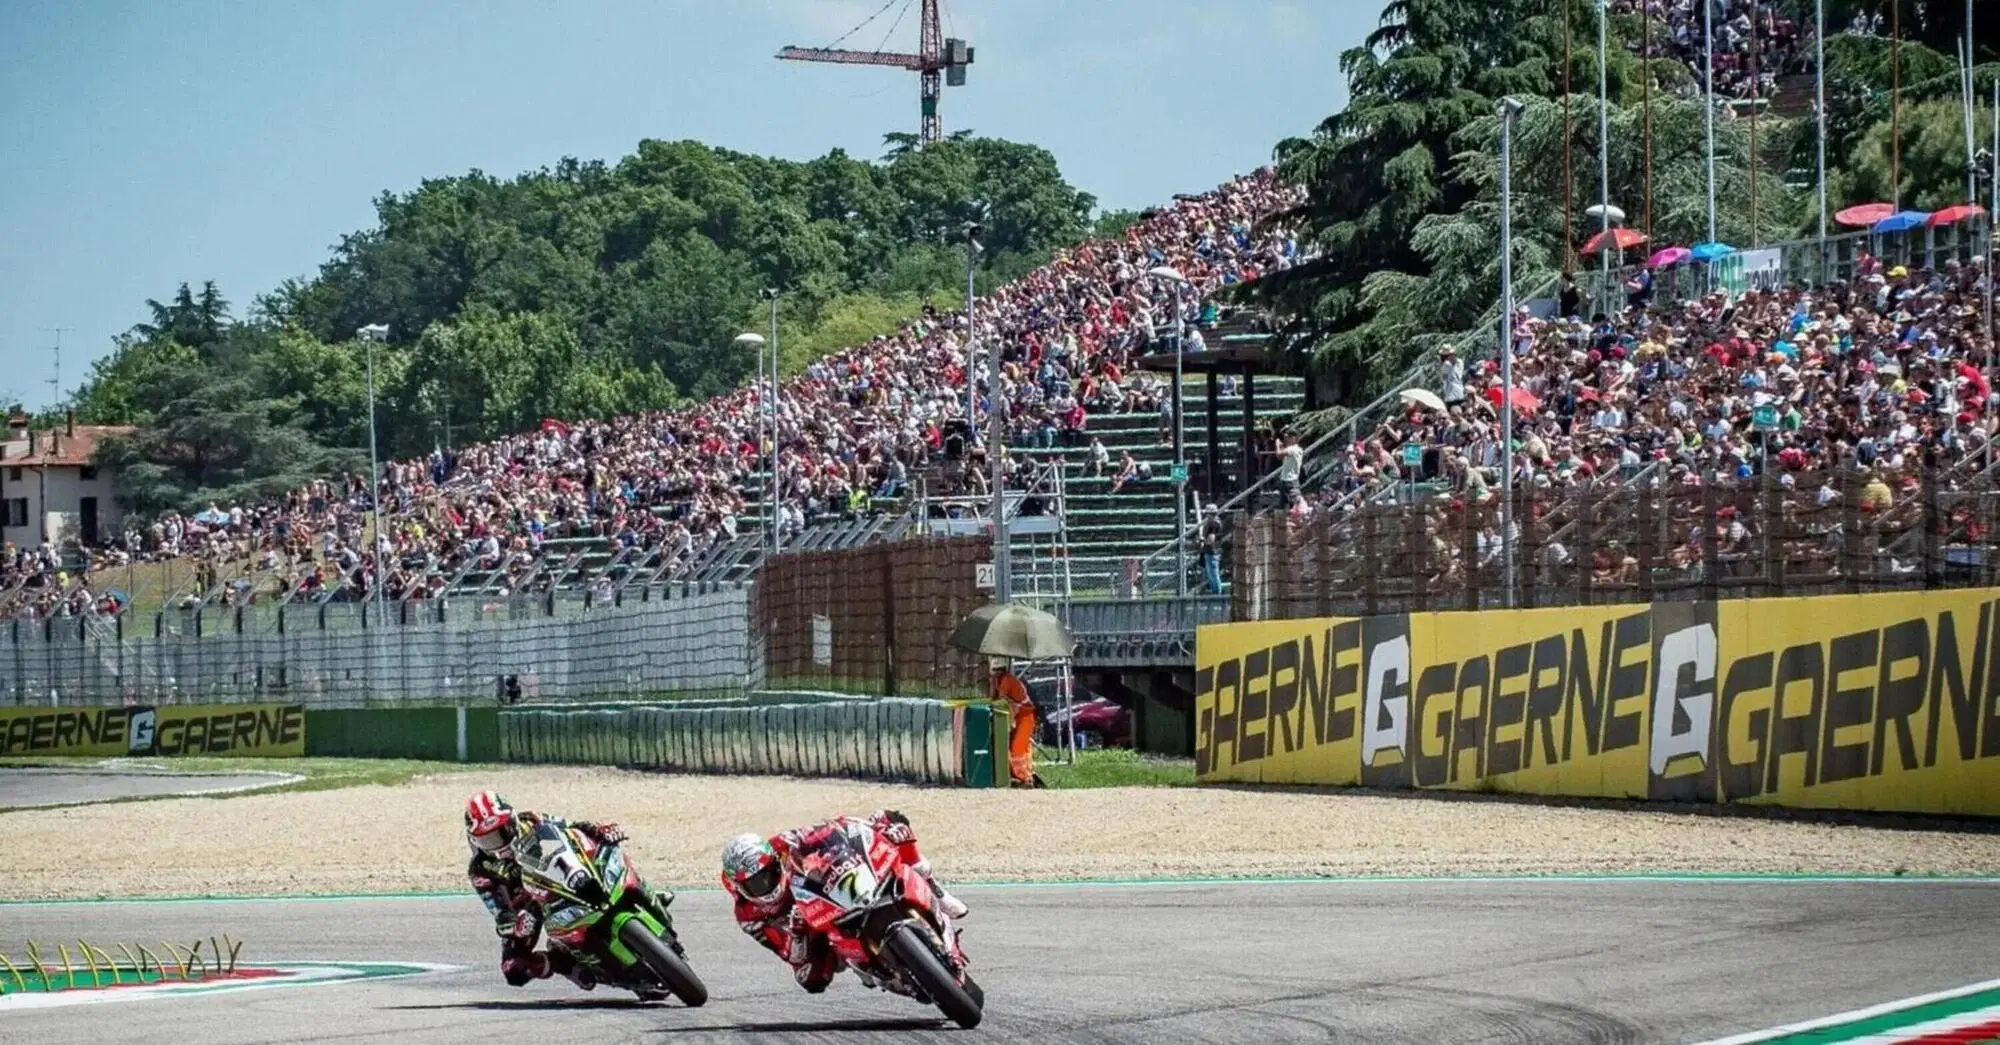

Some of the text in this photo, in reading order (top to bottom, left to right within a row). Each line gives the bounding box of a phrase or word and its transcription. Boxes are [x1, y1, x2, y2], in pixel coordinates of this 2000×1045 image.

[978, 567, 993, 584] 21
[1362, 634, 1409, 766] G
[1413, 609, 1650, 786] GAERNE
[1651, 623, 1716, 776] G
[156, 704, 303, 755] GAERNE
